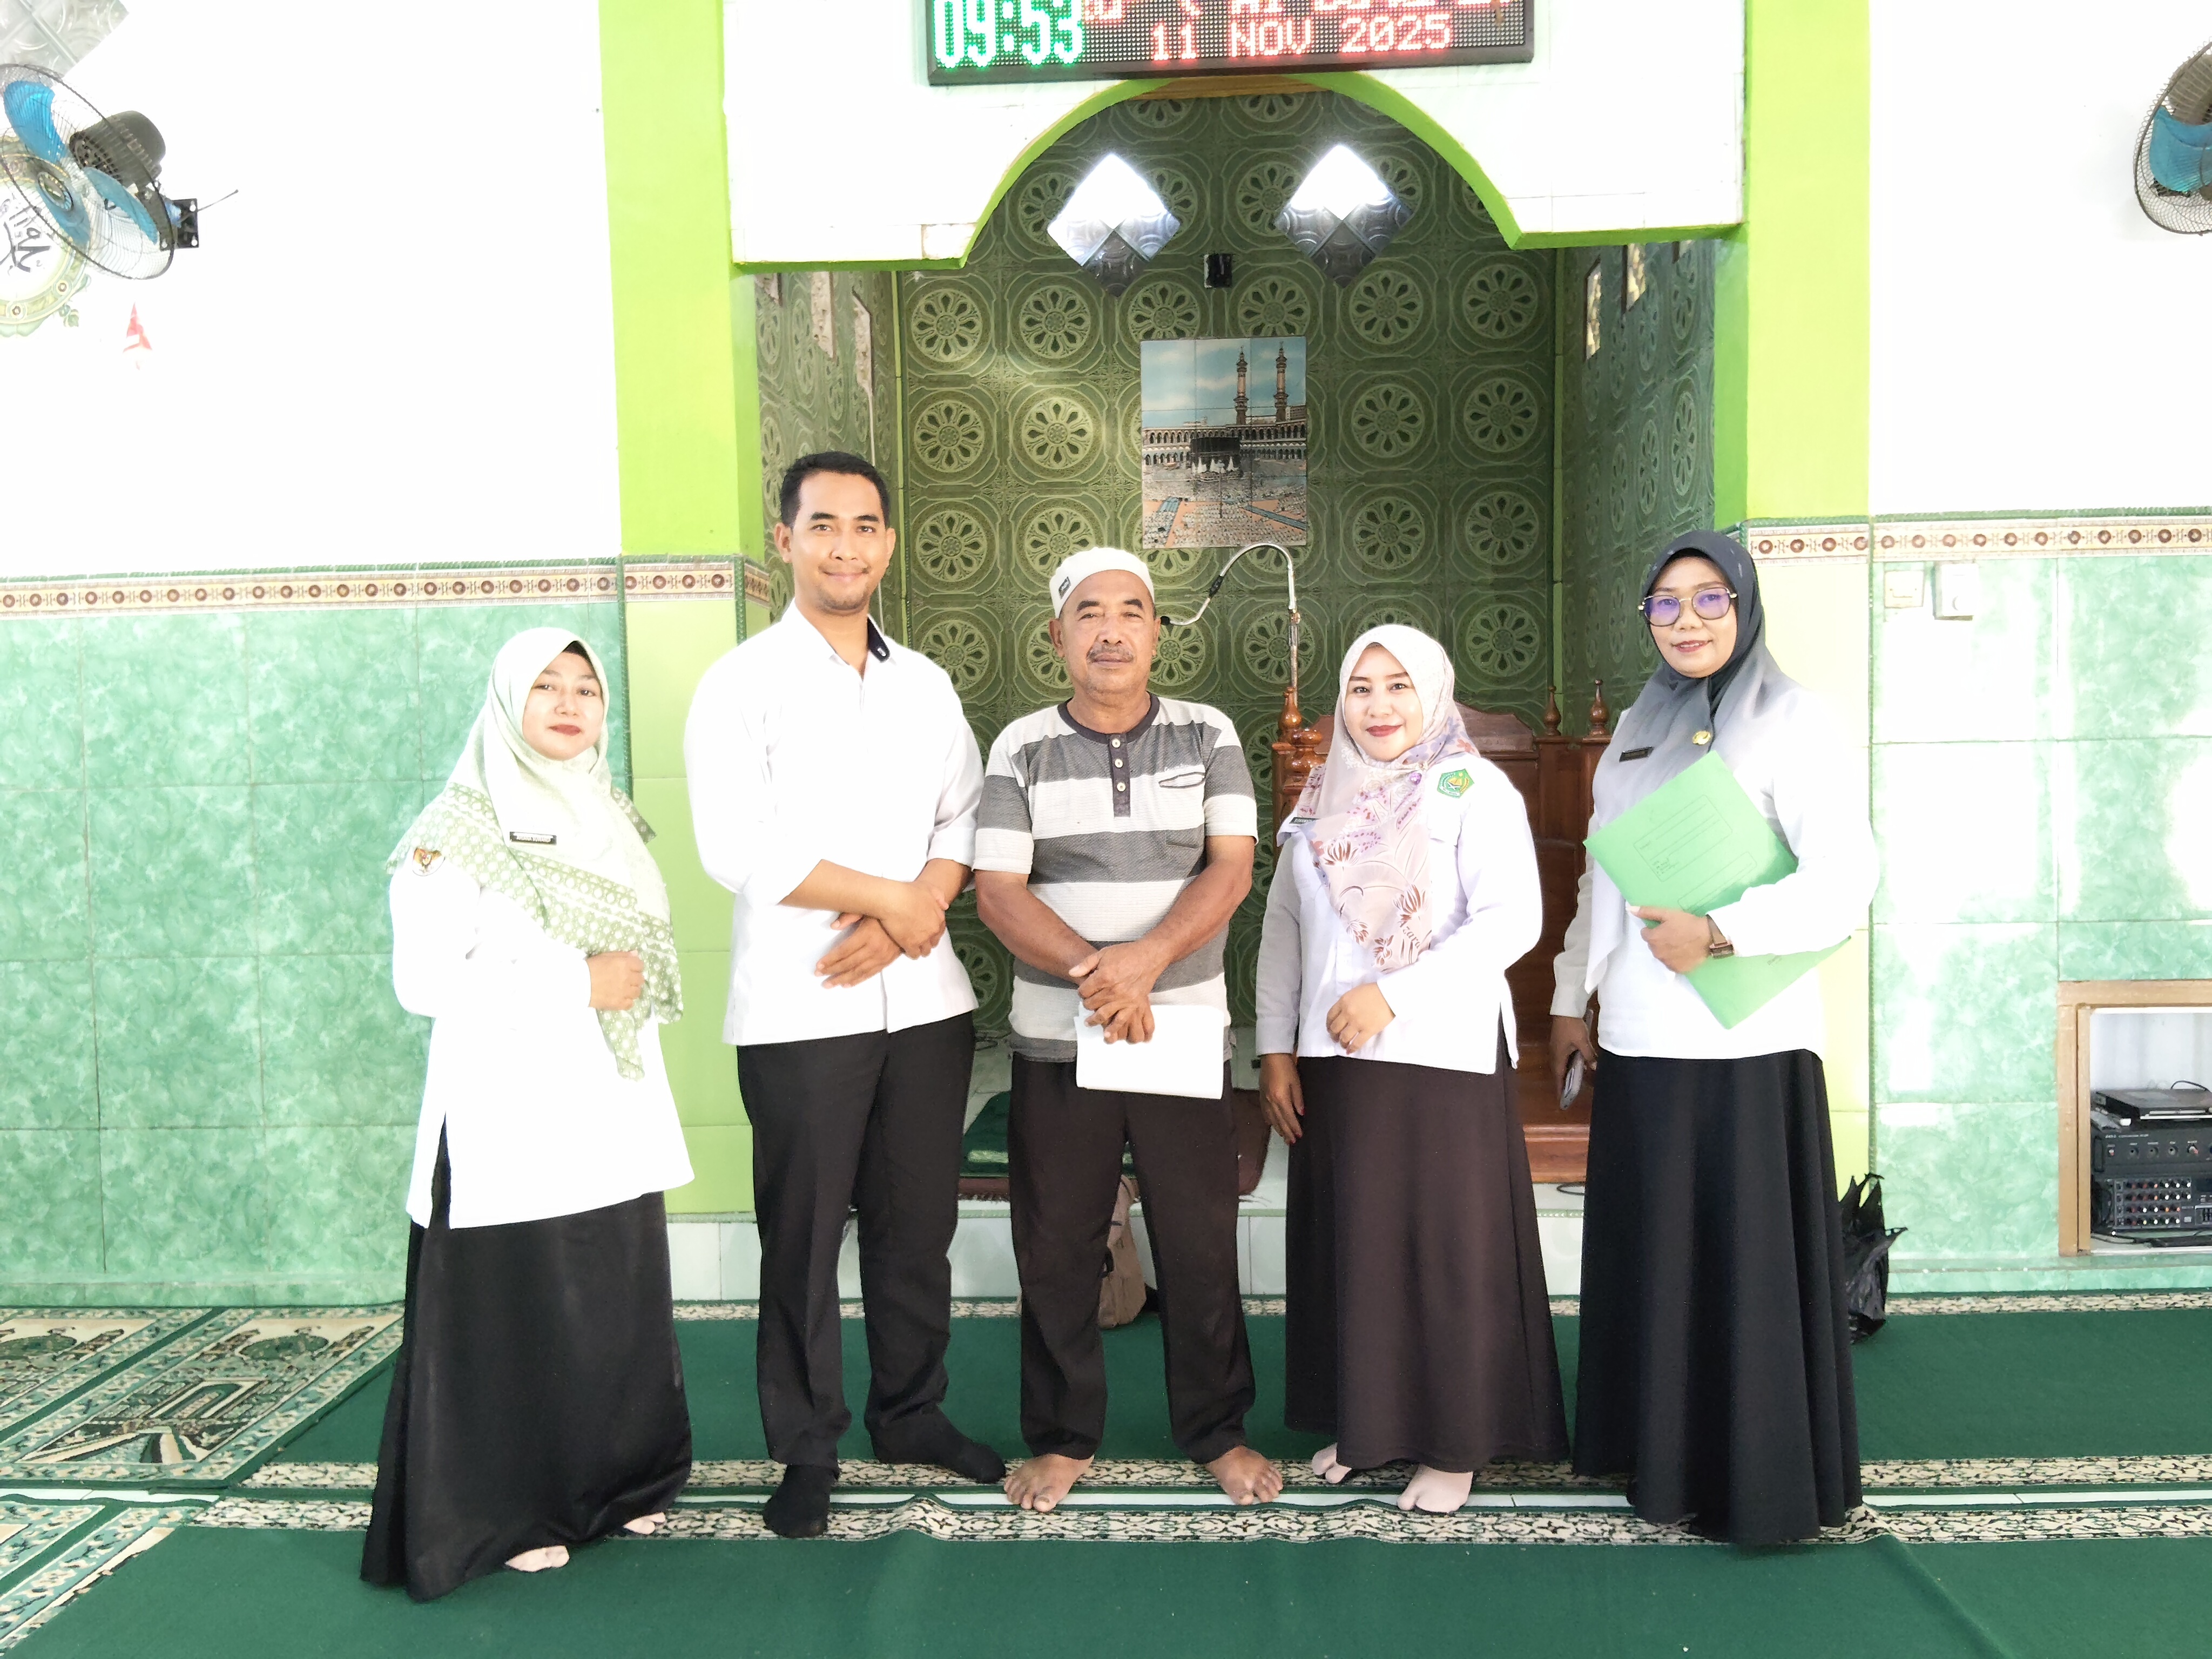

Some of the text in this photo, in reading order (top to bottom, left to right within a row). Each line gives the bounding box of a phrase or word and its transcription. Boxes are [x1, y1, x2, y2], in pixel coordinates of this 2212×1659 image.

[934, 0, 1082, 68] 09:53
[1152, 14, 1451, 60] 11 NOV 2025
